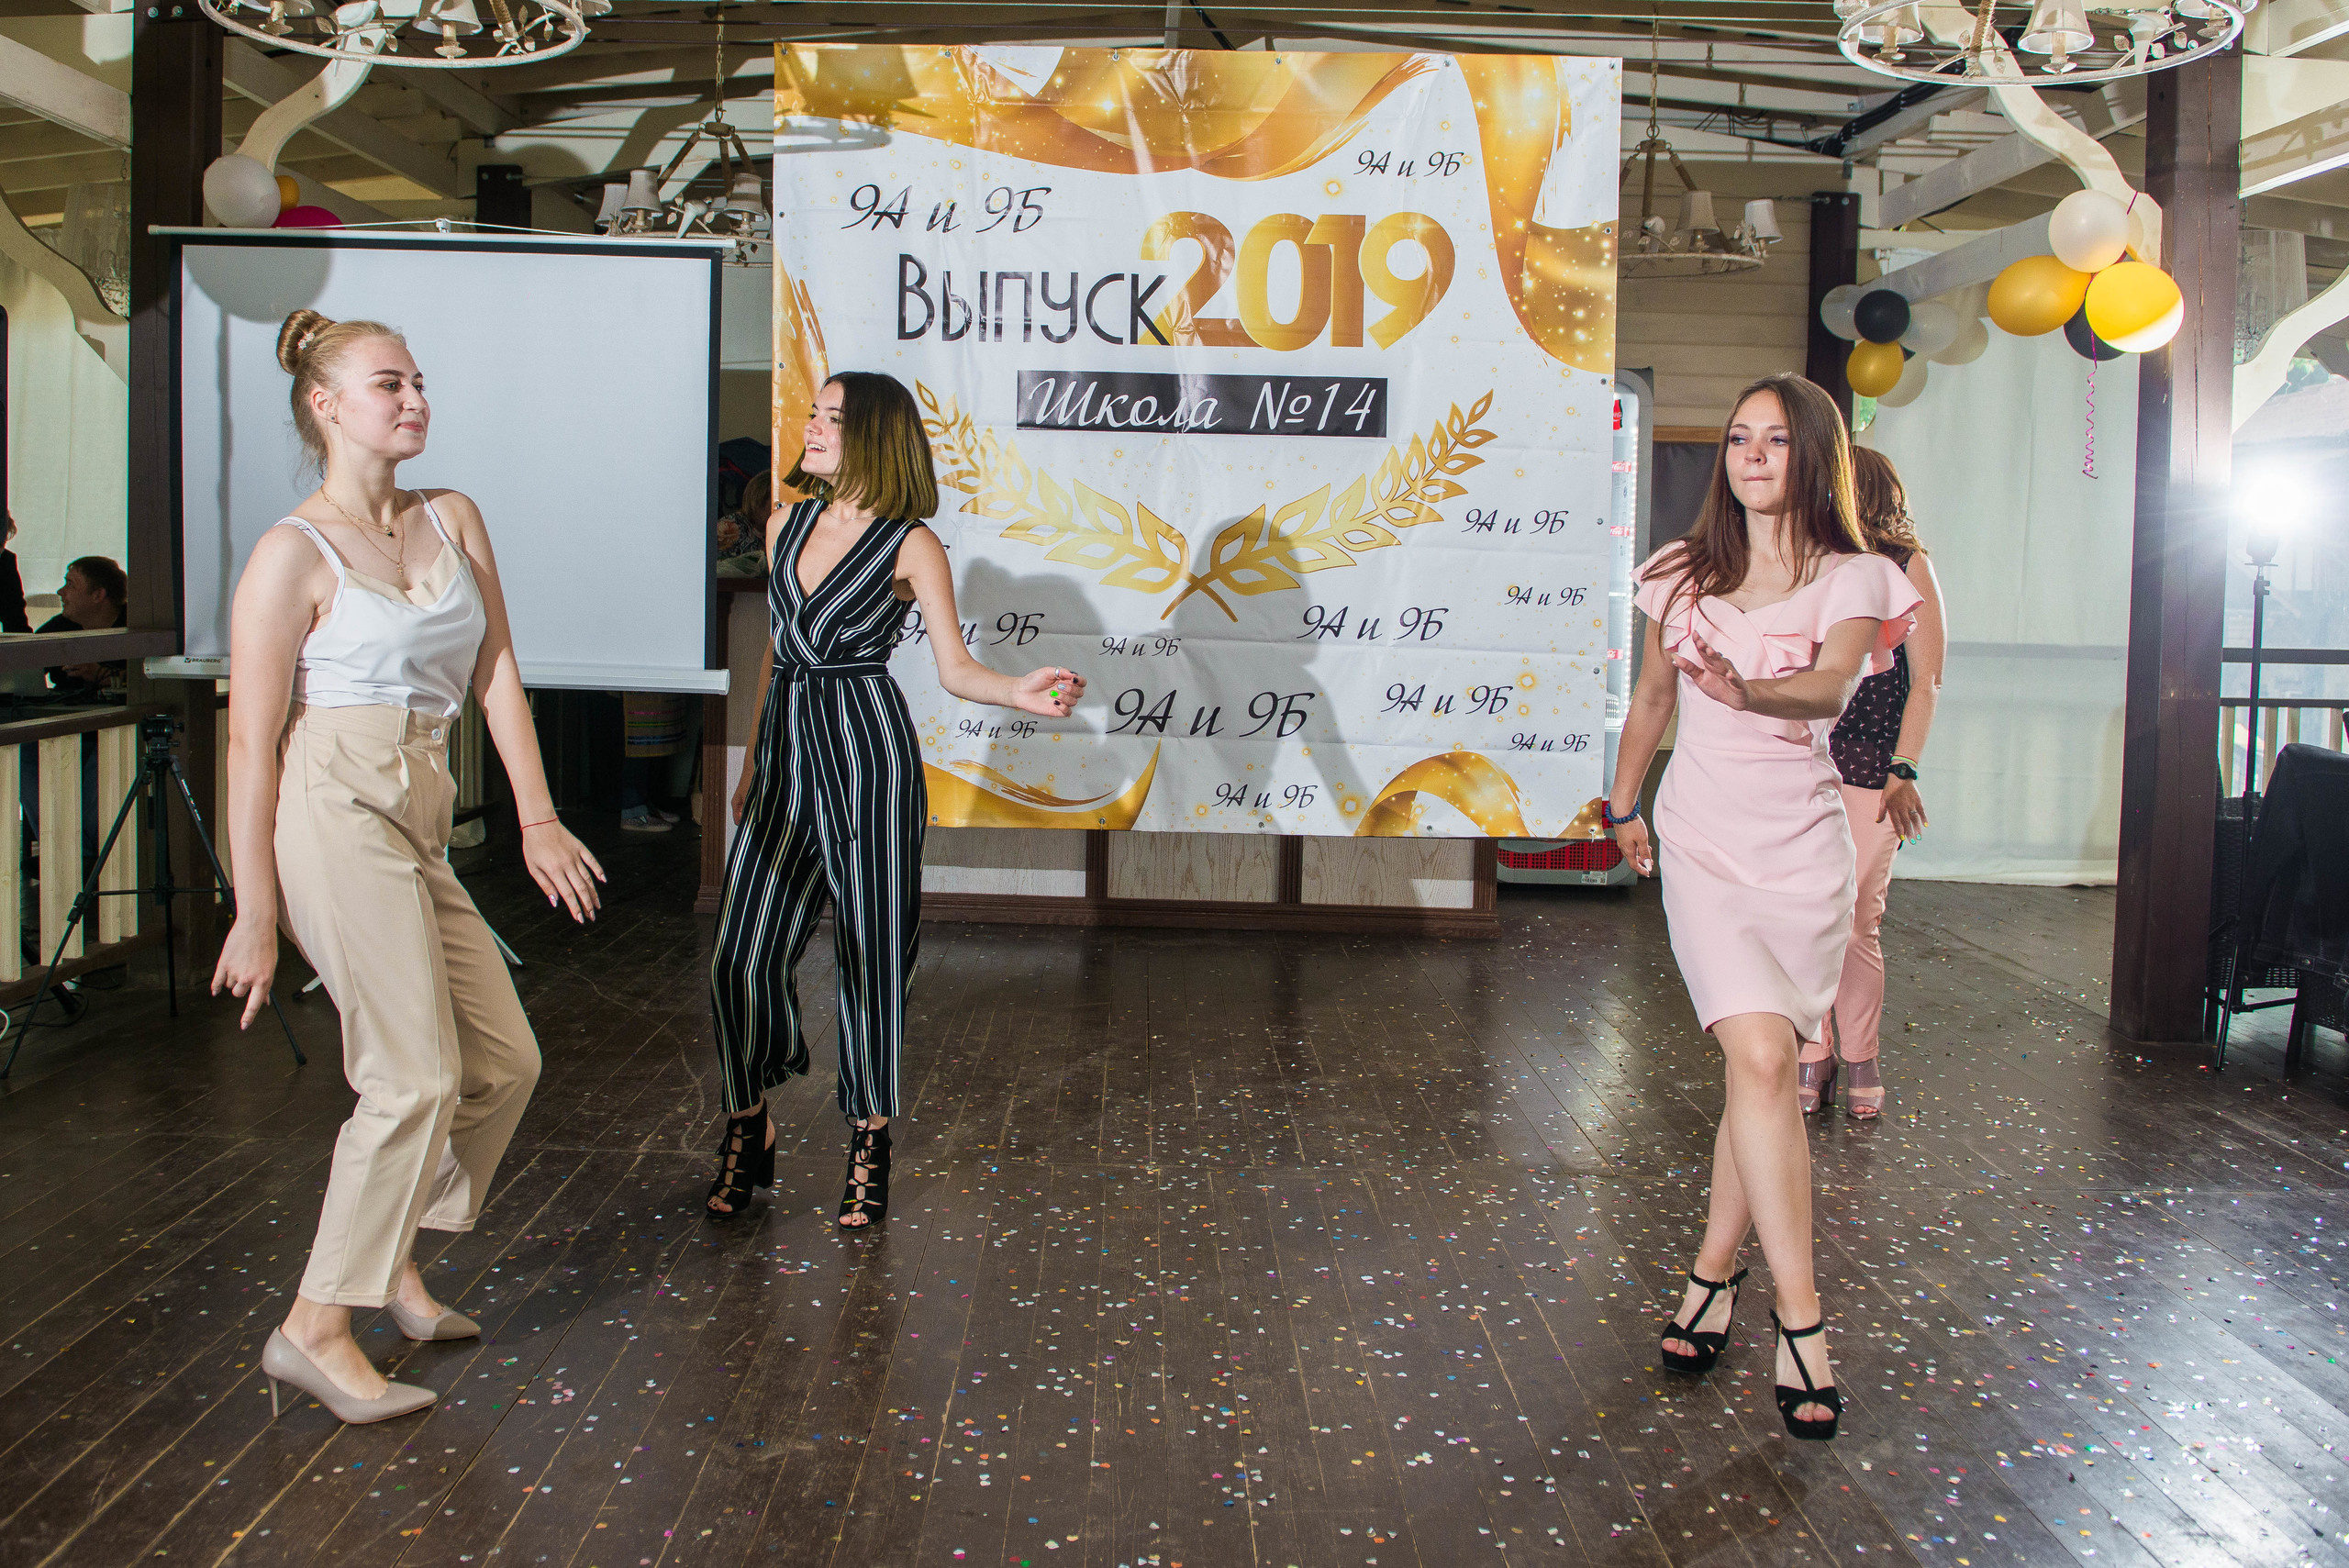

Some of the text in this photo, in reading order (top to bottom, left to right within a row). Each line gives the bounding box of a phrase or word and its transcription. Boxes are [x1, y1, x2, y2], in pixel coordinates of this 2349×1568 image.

[1353, 150, 1465, 178] 9А и 9Б
[841, 183, 1052, 234] 9А и 9Б
[1140, 211, 1456, 351] 2019
[1029, 377, 1377, 434] Школа №14
[1461, 508, 1569, 535] 9А и 9Б
[1504, 585, 1587, 606] 9А и 9Б
[989, 612, 1045, 646] 9Б
[1296, 605, 1450, 641] 9А и 9Б
[1098, 636, 1182, 657] 9А и 9Б
[1105, 688, 1316, 739] 9А и 9Б
[1380, 683, 1514, 715] 9А и 9Б
[955, 718, 1039, 740] 9А и 9Б
[1507, 732, 1591, 752] 9А и 9Б
[1210, 783, 1319, 809] 9А и 9Б
